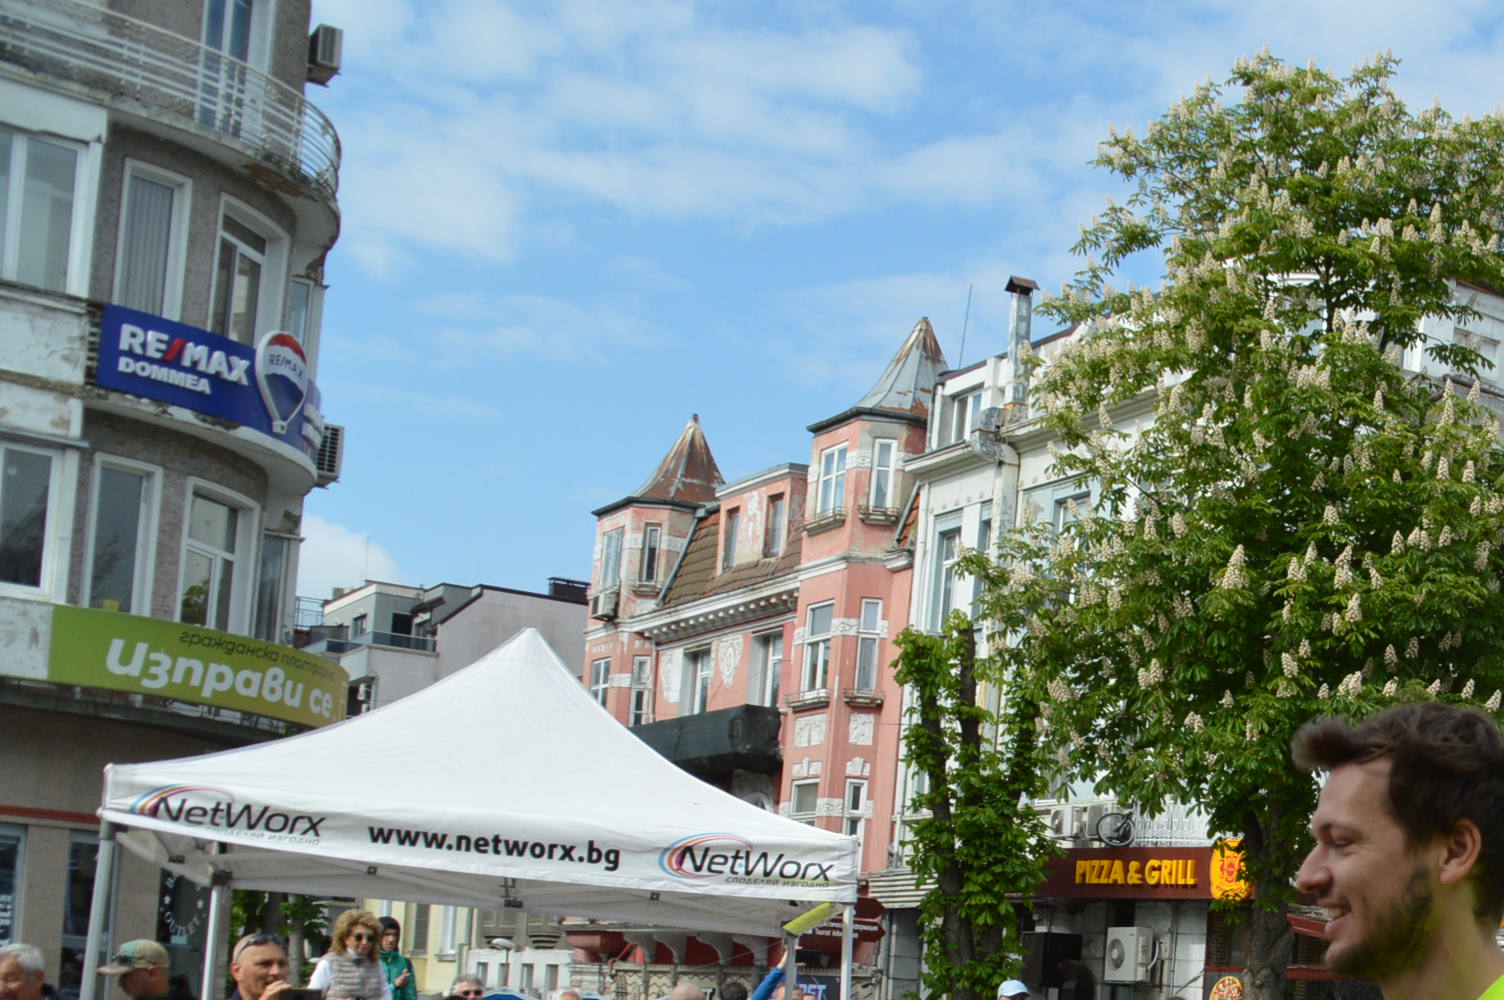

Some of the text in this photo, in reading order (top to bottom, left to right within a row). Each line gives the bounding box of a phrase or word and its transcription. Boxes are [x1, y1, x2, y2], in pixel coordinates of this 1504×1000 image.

[119, 323, 251, 386] RE/MAX
[117, 356, 212, 395] DOMMEA
[179, 631, 279, 662] гражданска
[153, 796, 326, 838] NetWorx
[368, 826, 620, 871] www.networx.bg
[680, 846, 834, 881] NetWorx
[1075, 859, 1198, 885] PIZZA & GRILL
